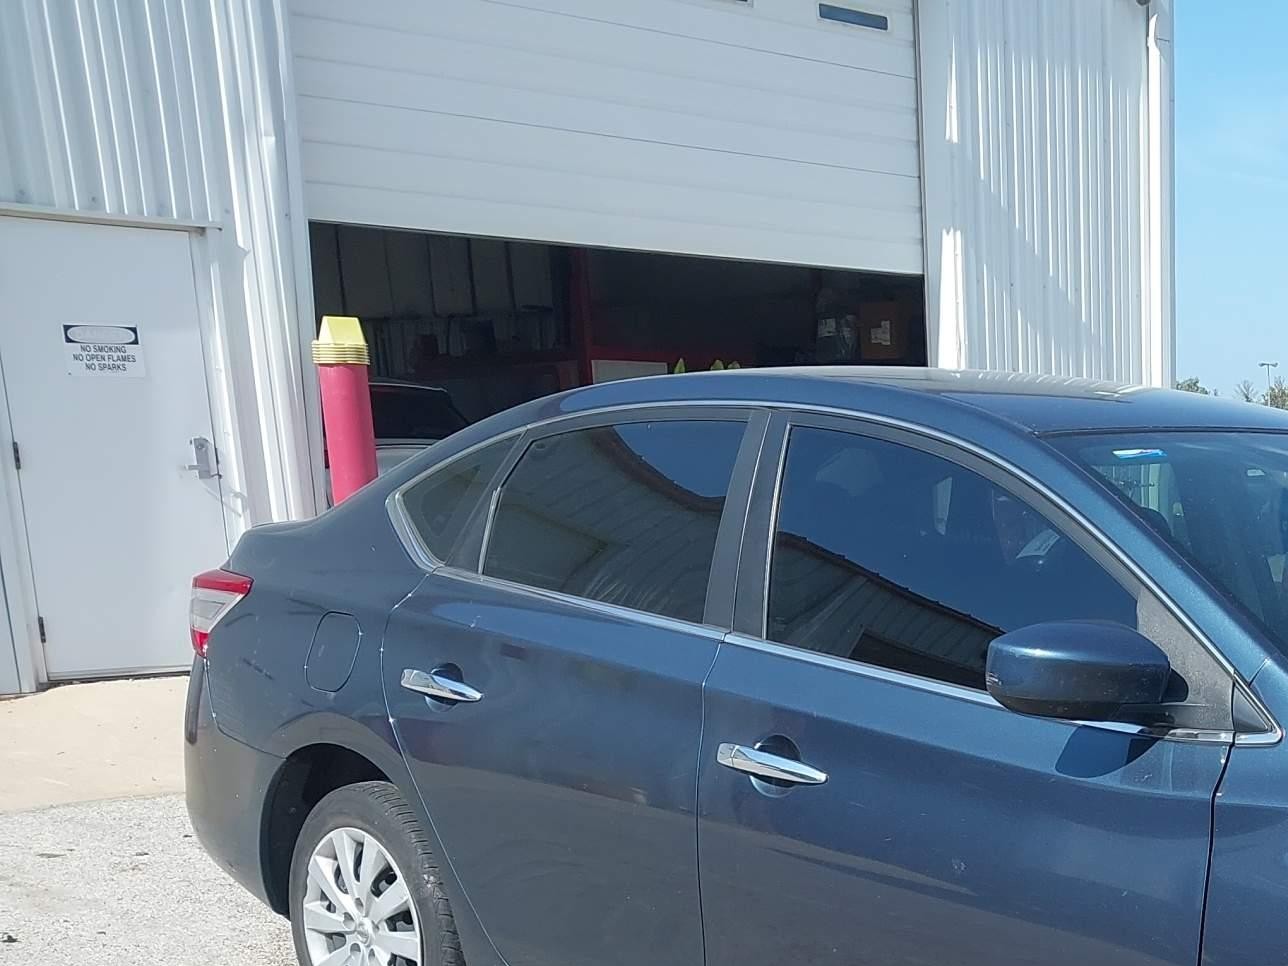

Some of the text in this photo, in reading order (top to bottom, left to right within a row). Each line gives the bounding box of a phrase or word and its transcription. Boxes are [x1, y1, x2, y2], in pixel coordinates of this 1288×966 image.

[80, 345, 127, 353] NO SMOKING
[72, 353, 136, 362] NO OPEN FLAMES
[85, 363, 127, 371] NO SPARKS
